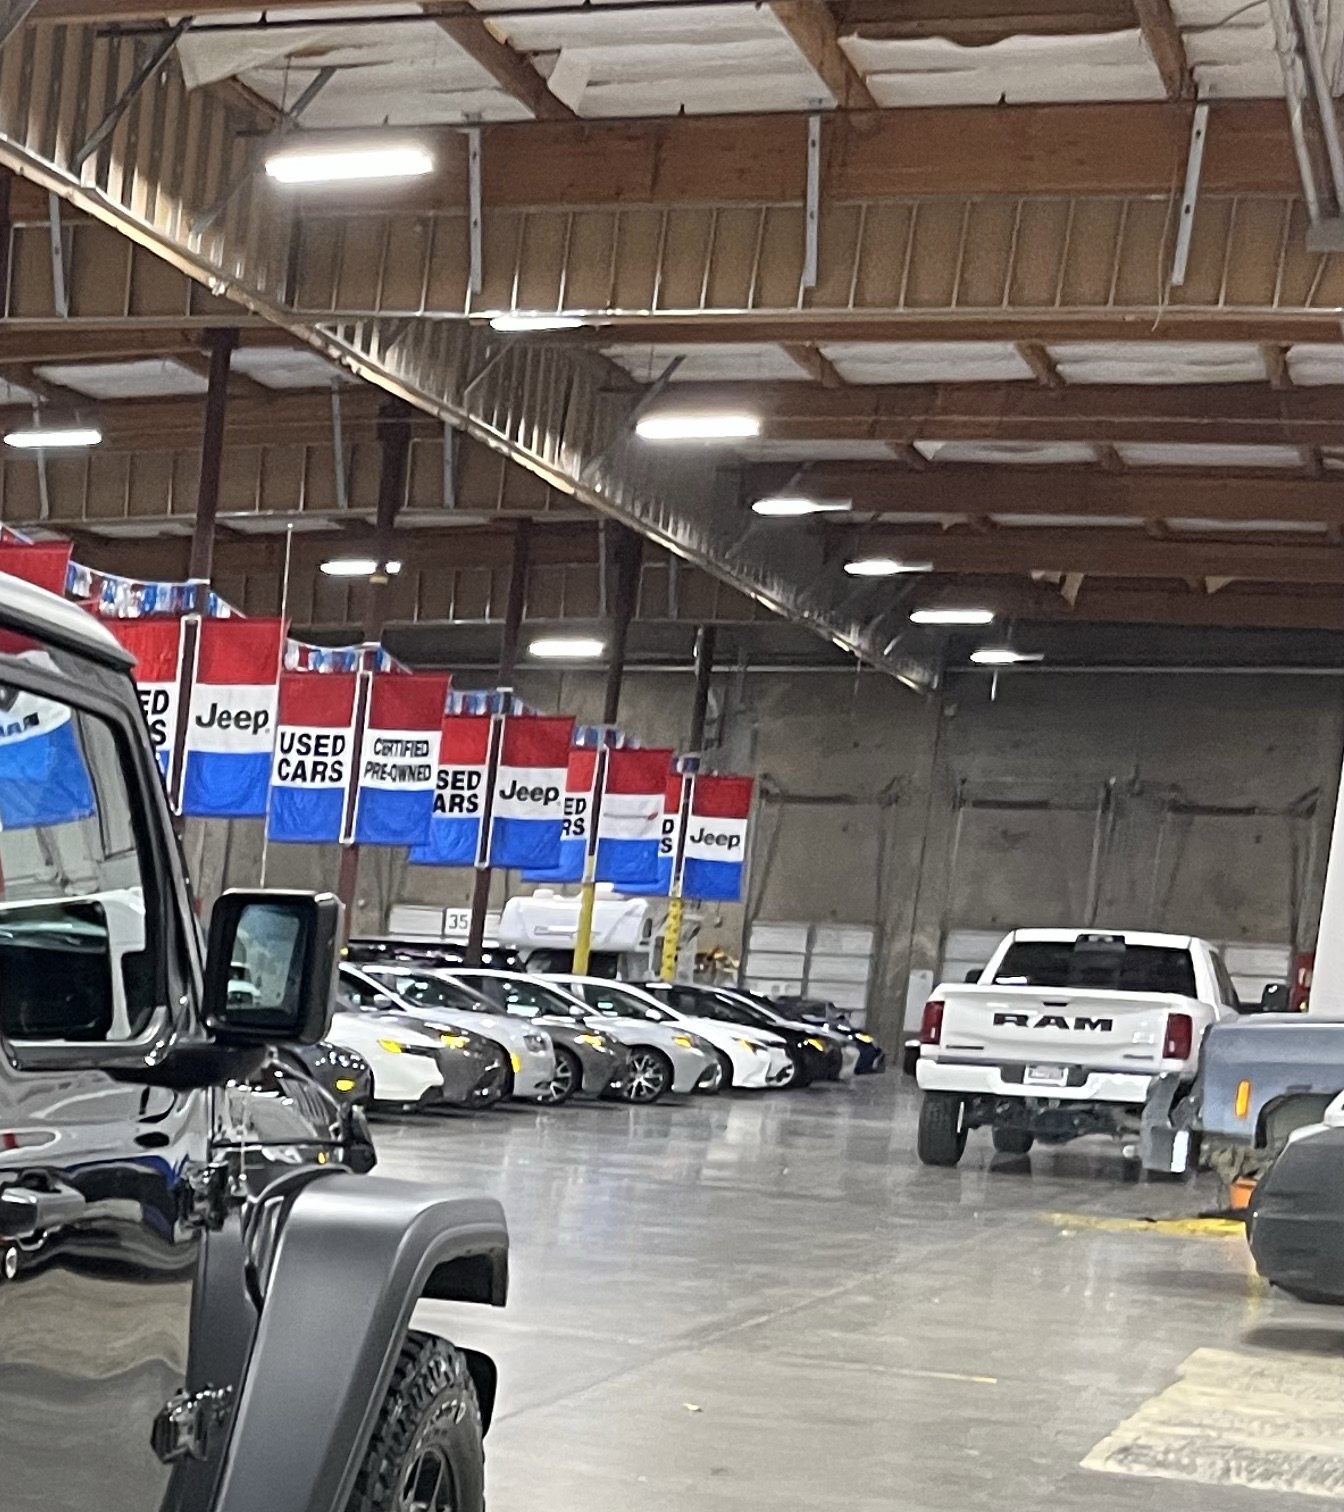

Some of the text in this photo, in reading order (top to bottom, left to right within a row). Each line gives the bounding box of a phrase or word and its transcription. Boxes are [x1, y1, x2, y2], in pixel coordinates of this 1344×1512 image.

[138, 689, 169, 715] ED
[195, 702, 269, 736] Jeep
[280, 731, 346, 757] USED
[373, 738, 430, 758] CERTIFIED
[277, 758, 344, 783] CARS
[363, 761, 432, 783] PRE-OWNED
[436, 769, 482, 791] SED
[432, 793, 479, 813] ARS
[498, 780, 560, 806] Jeep
[564, 797, 587, 815] ED
[562, 817, 586, 836] RS
[690, 828, 741, 850] Jeep
[448, 914, 469, 930] 35
[993, 1013, 1113, 1032] RAM
